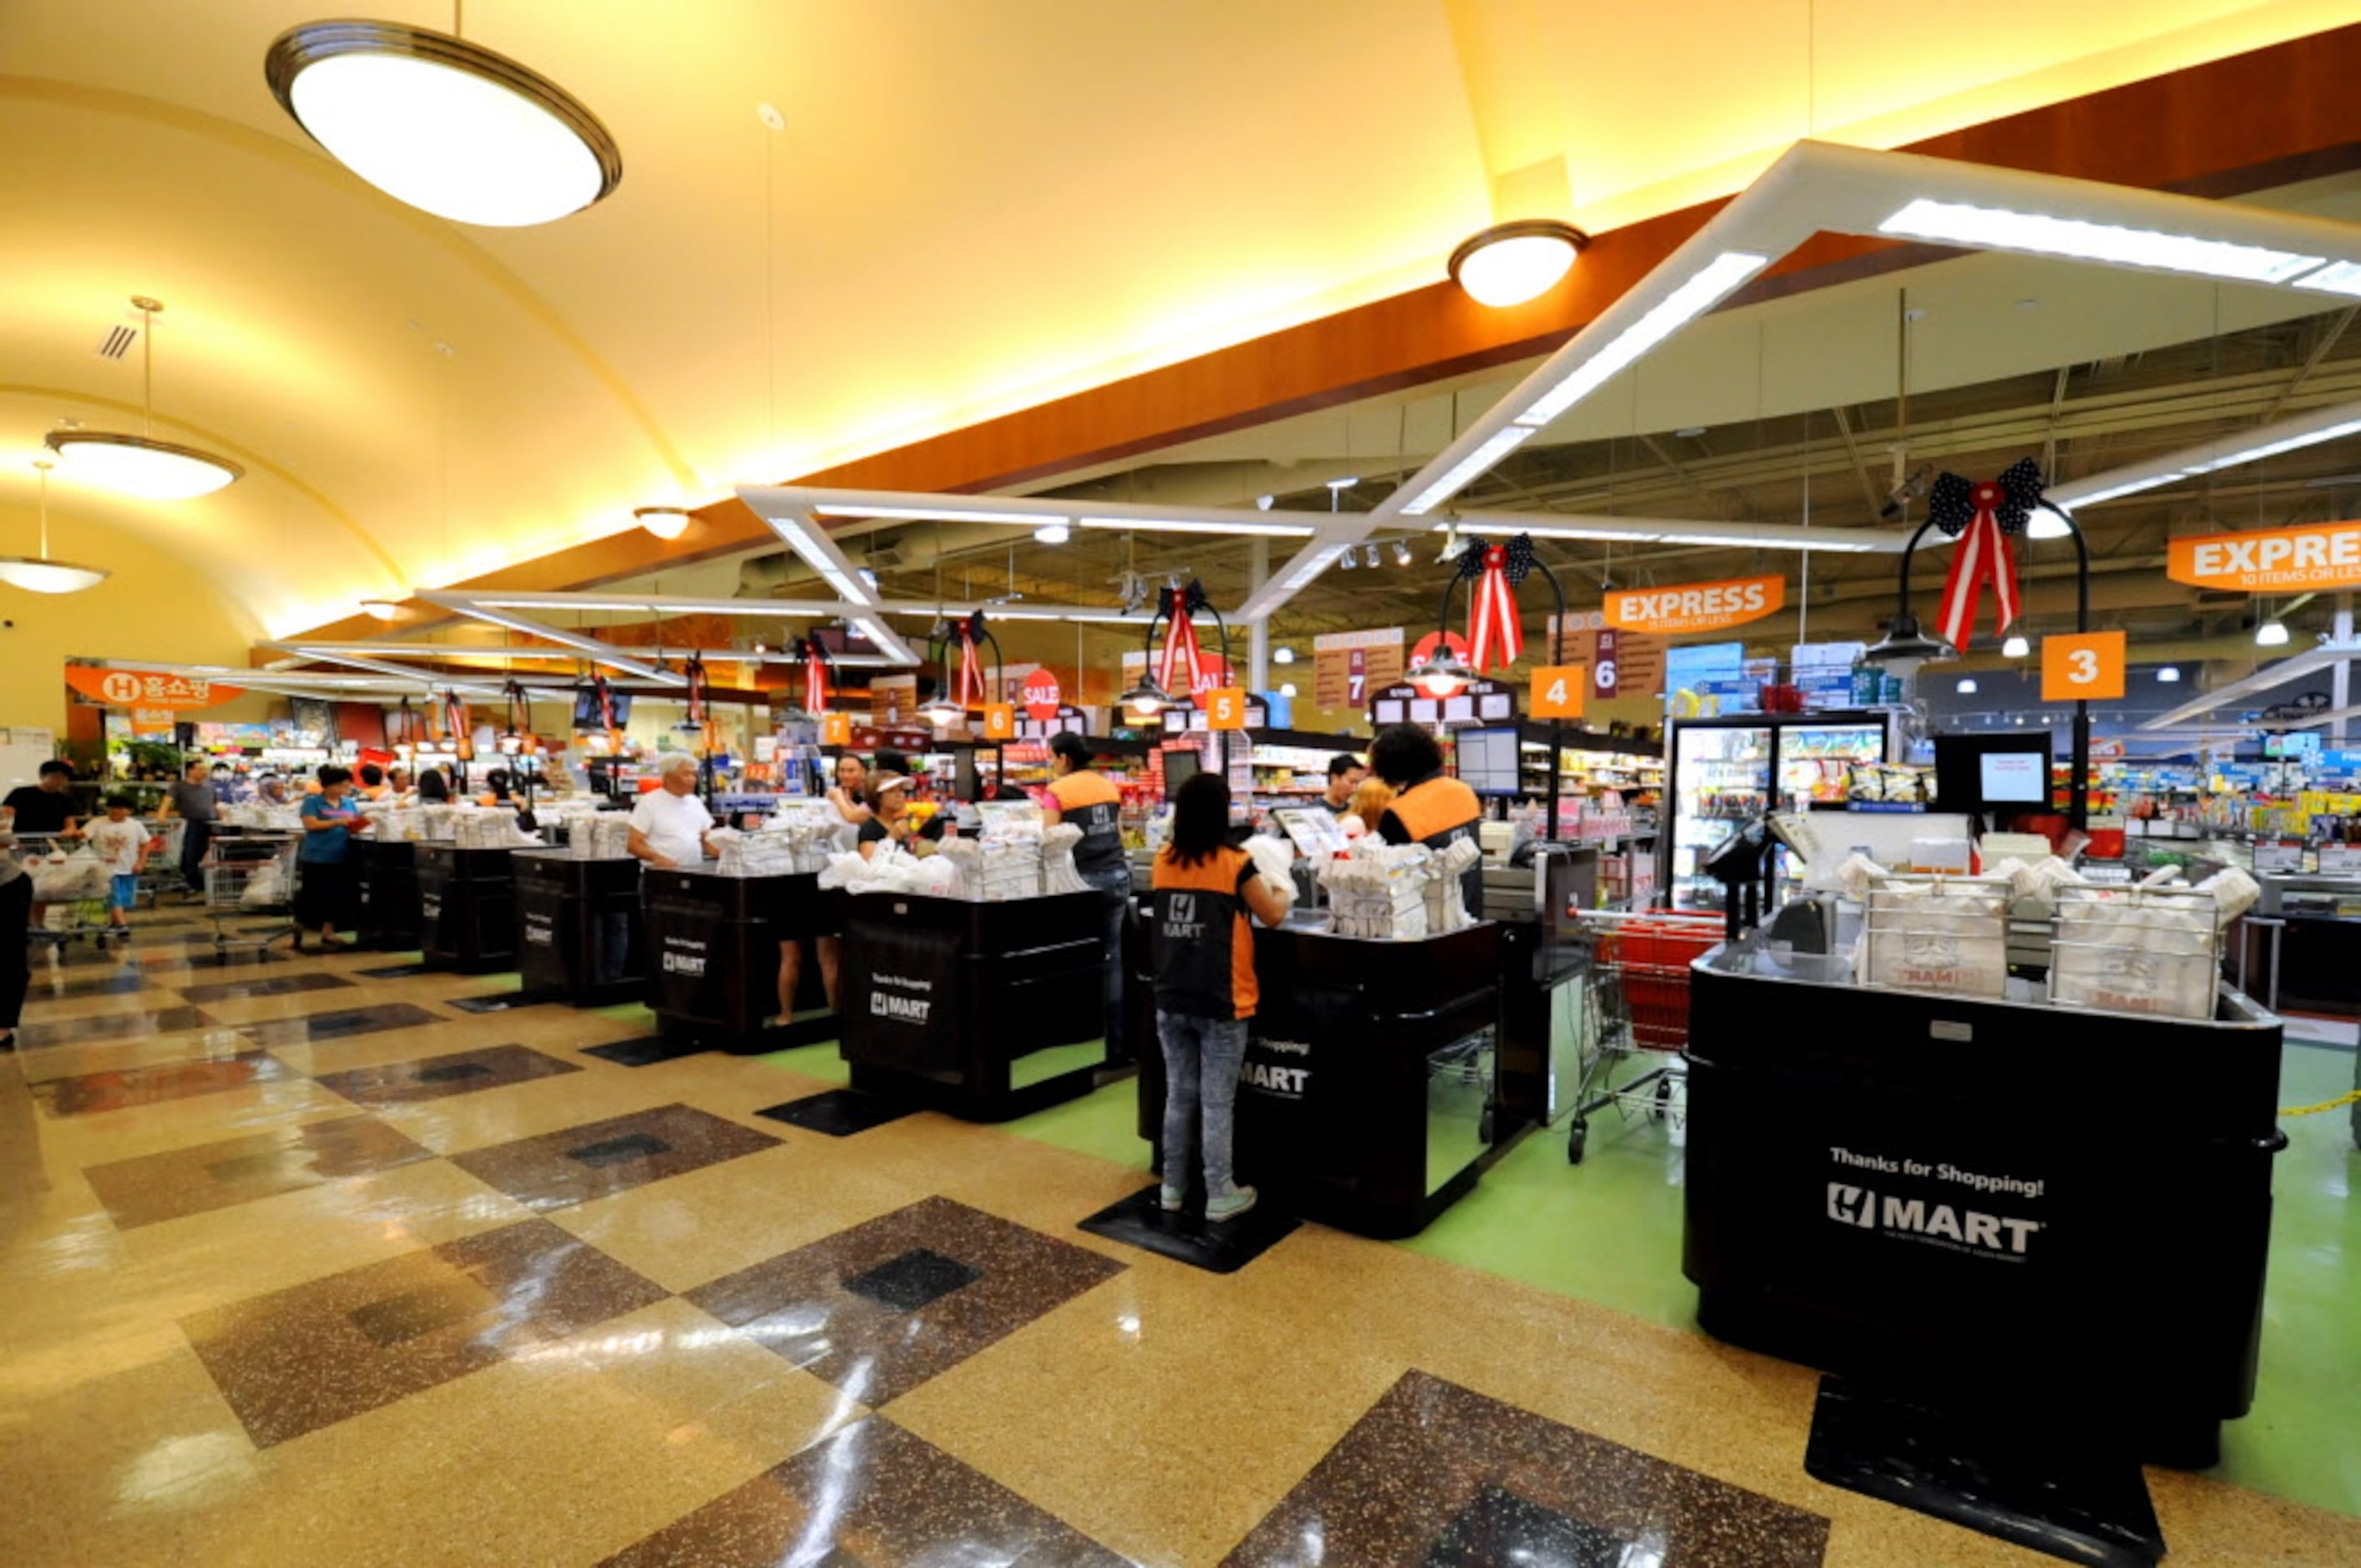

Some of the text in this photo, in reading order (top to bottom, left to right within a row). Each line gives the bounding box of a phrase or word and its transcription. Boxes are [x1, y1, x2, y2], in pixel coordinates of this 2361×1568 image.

[2241, 574, 2255, 585] 10
[2260, 571, 2306, 583] ITEMS
[2310, 567, 2334, 580] OR
[1620, 584, 1765, 621] EXPRESS
[1595, 660, 1615, 689] 6
[2067, 649, 2100, 685] 3
[1024, 685, 1059, 704] SALE
[1348, 675, 1364, 700] 7
[1546, 679, 1567, 706] 4
[992, 712, 1004, 731] 6
[1216, 697, 1231, 721] 5
[831, 721, 842, 736] 7
[888, 995, 930, 1020] MART
[1830, 1146, 2045, 1198] Thanks for Shopping!
[1883, 1196, 2040, 1253] MART
